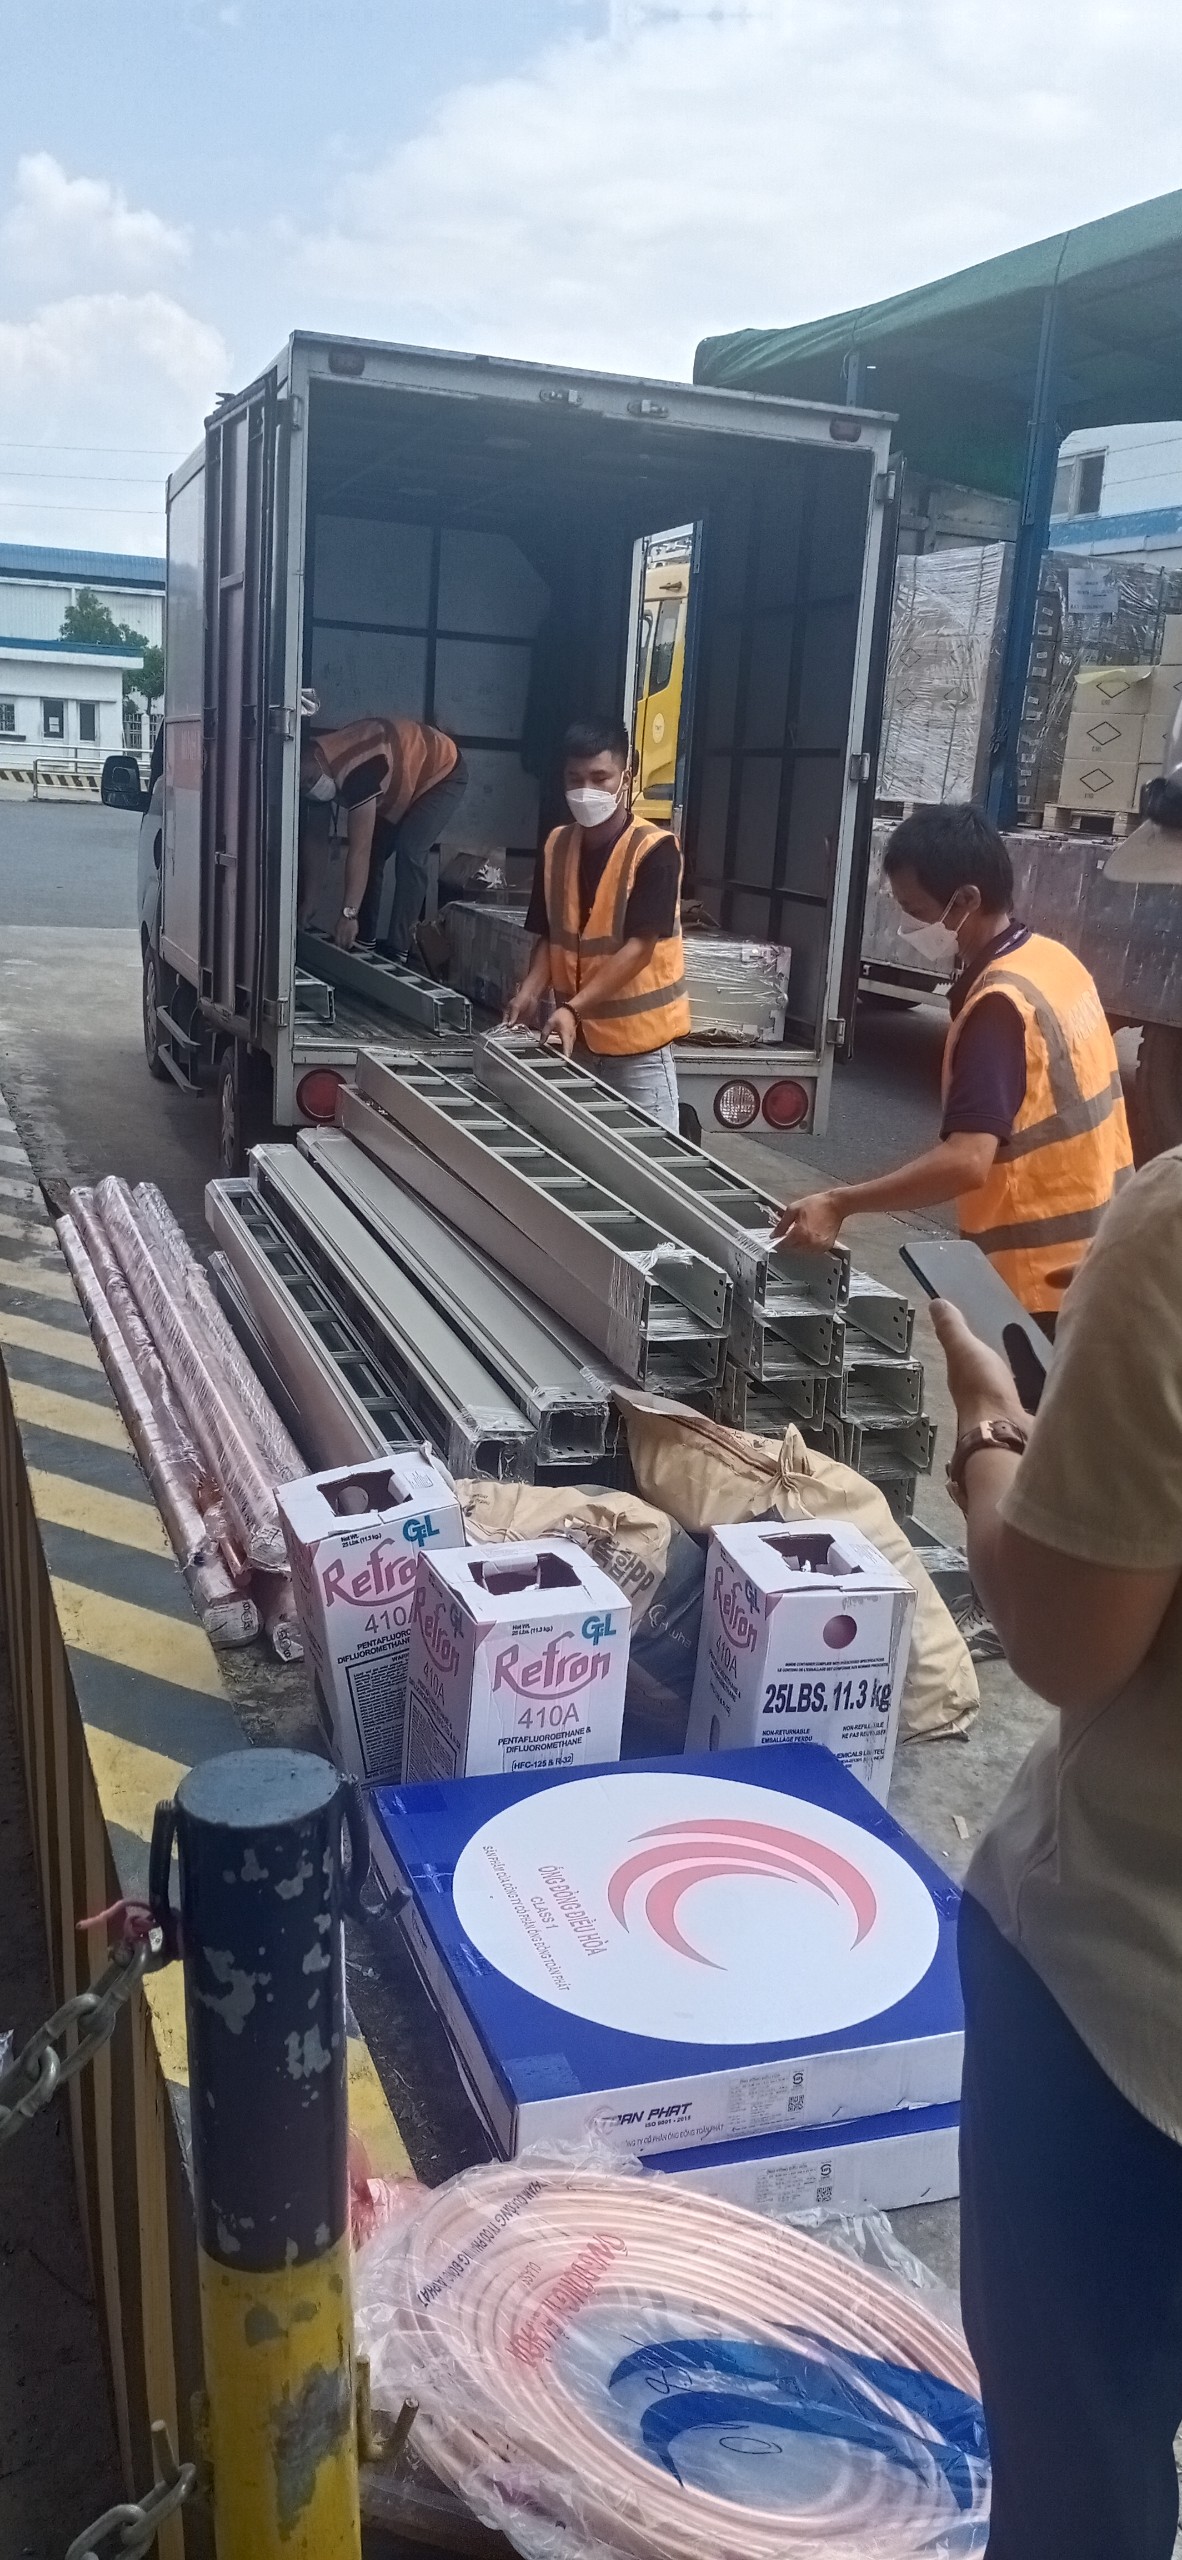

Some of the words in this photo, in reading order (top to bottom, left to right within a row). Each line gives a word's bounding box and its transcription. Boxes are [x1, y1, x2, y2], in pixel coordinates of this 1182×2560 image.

[322, 1537, 417, 1608] Refro
[492, 1630, 611, 1701] Refron
[762, 1682, 828, 1714] 25LBS.
[833, 1679, 868, 1711] 11.3
[870, 1678, 892, 1713] kg
[517, 1702, 580, 1729] 410A
[498, 1728, 584, 1746] PENTAFLUOROETHANE
[506, 1736, 583, 1754] DIFLUOROMETHANE
[762, 1728, 811, 1736] NON-RETURNABLE
[530, 1896, 555, 1924] CLASS
[577, 1932, 609, 1957] HÒA
